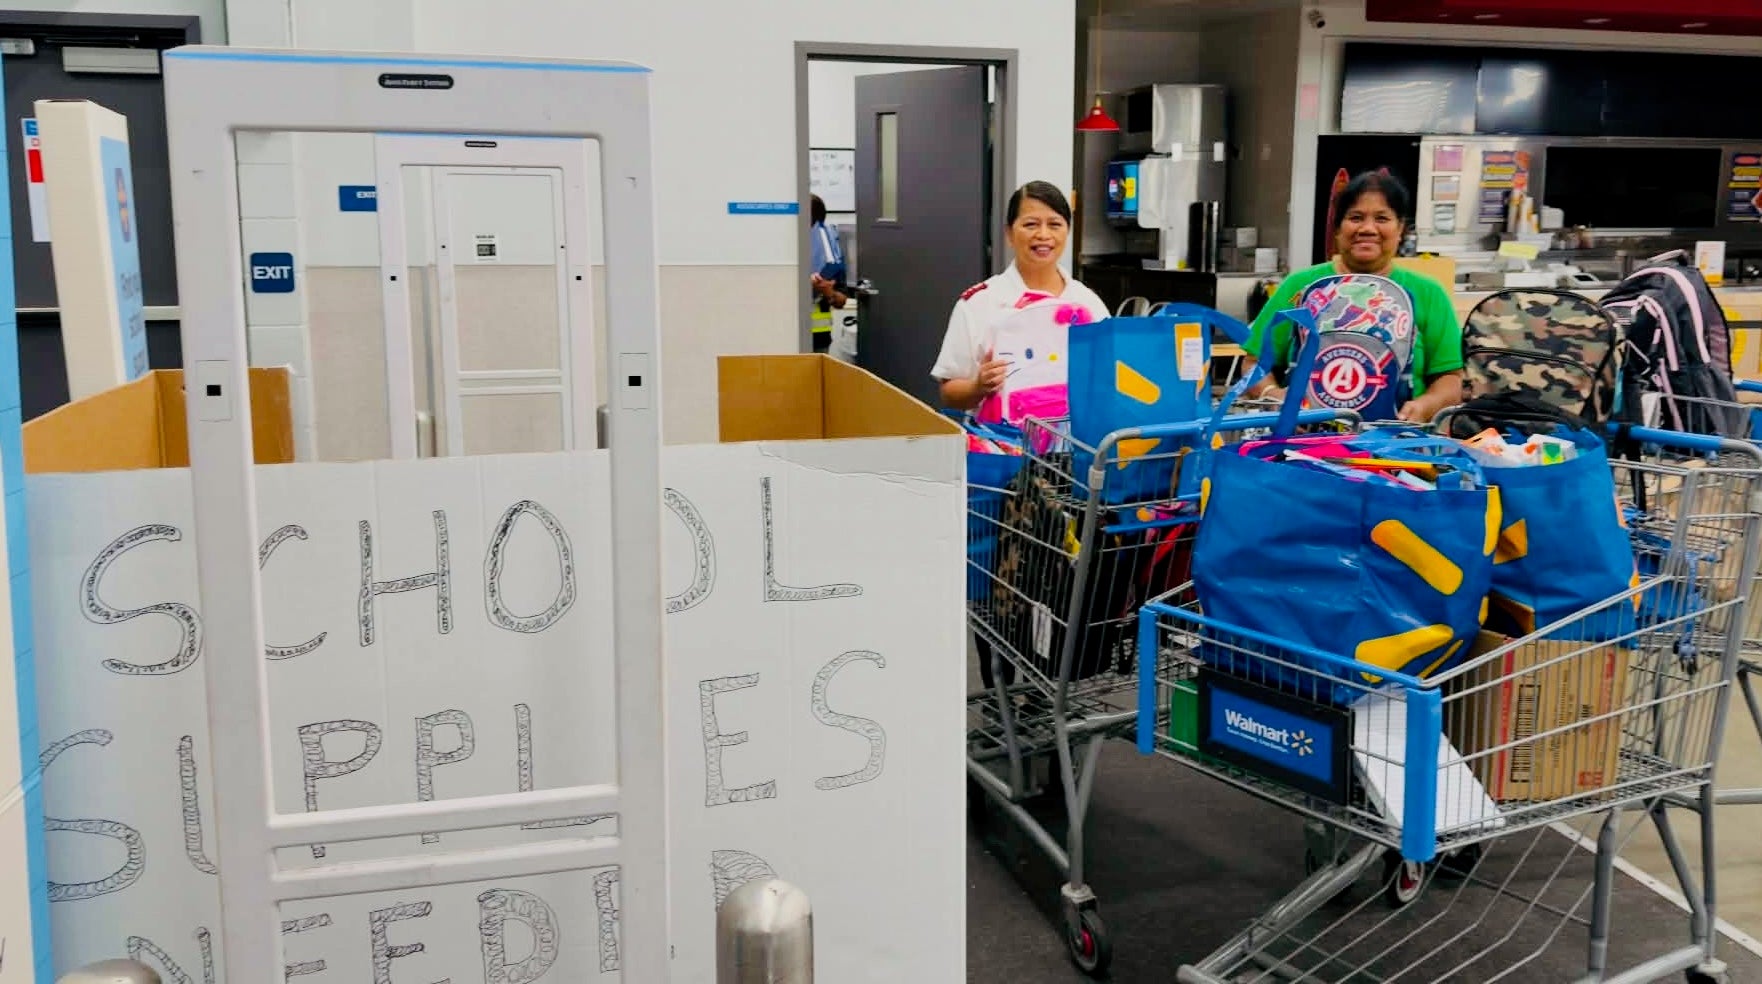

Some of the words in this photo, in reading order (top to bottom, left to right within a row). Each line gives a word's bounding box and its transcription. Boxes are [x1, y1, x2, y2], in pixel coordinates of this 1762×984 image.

[253, 266, 291, 280] EXIT
[1225, 708, 1290, 746] Walmart
[39, 650, 887, 902] SPPLES
